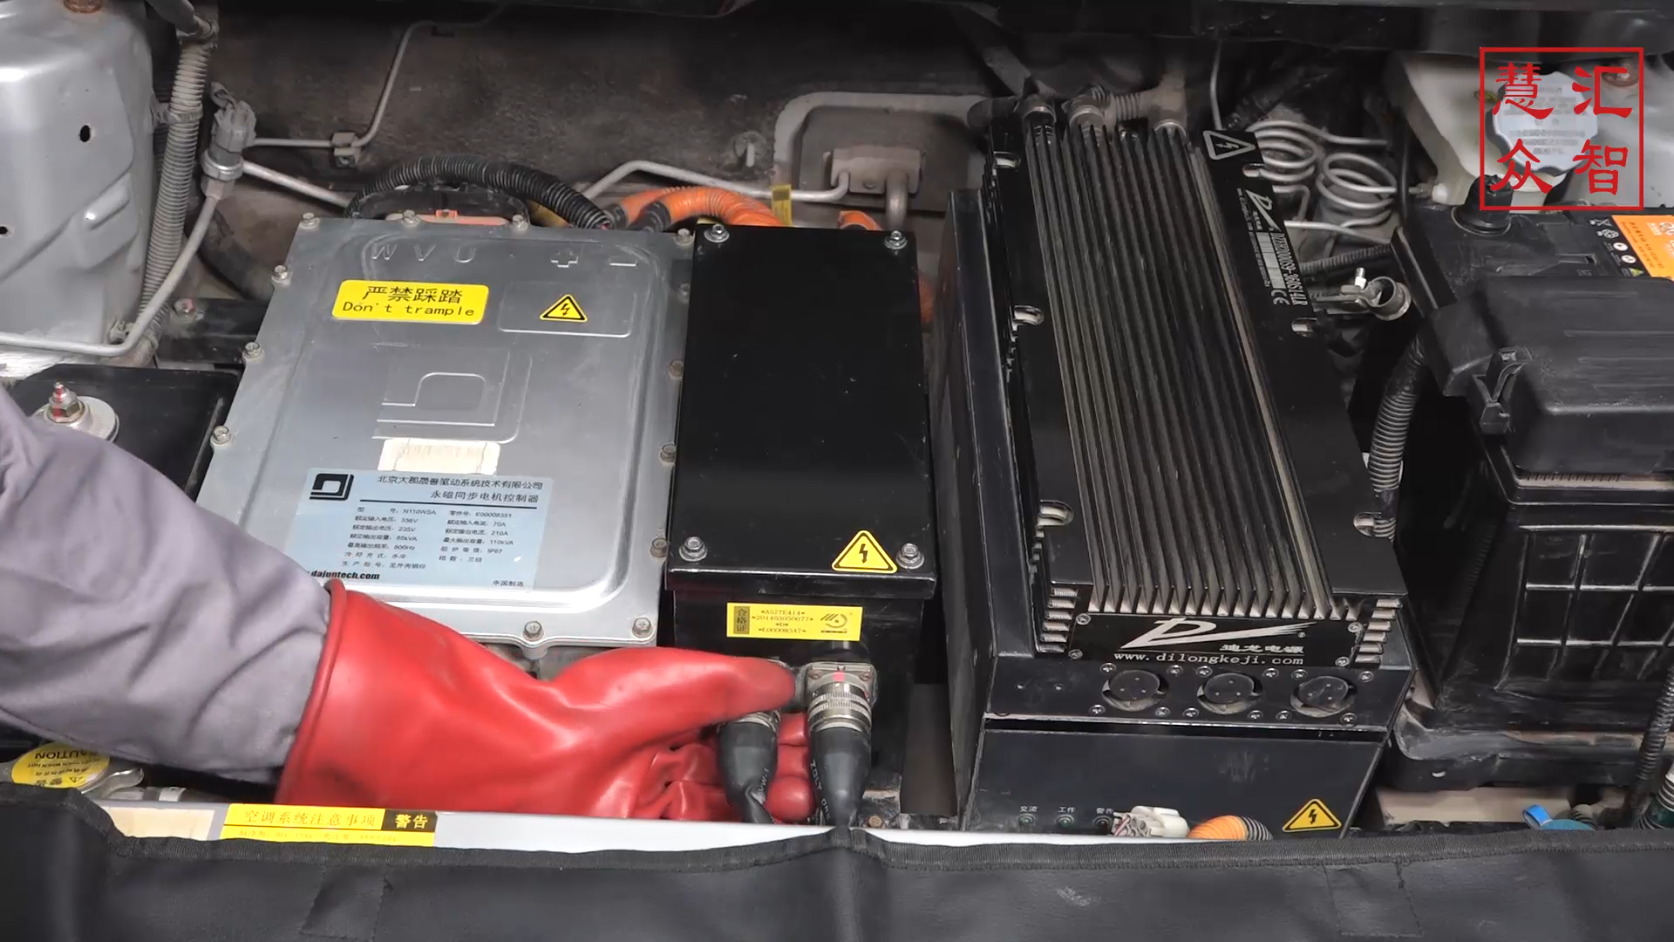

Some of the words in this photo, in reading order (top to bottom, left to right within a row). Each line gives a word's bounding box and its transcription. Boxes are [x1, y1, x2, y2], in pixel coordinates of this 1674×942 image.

[362, 285, 463, 305] 严禁踩踏
[342, 300, 393, 314] Don't
[404, 302, 476, 318] trample
[430, 490, 539, 503] 永磁同步电机控制器
[307, 570, 381, 580] dajuntech.com
[493, 579, 524, 587] 中国制造
[1219, 644, 1304, 654] 迪龙电源
[1020, 805, 1038, 813] 交流
[244, 809, 377, 827] 空调系统注意事项
[394, 813, 428, 829] 警告
